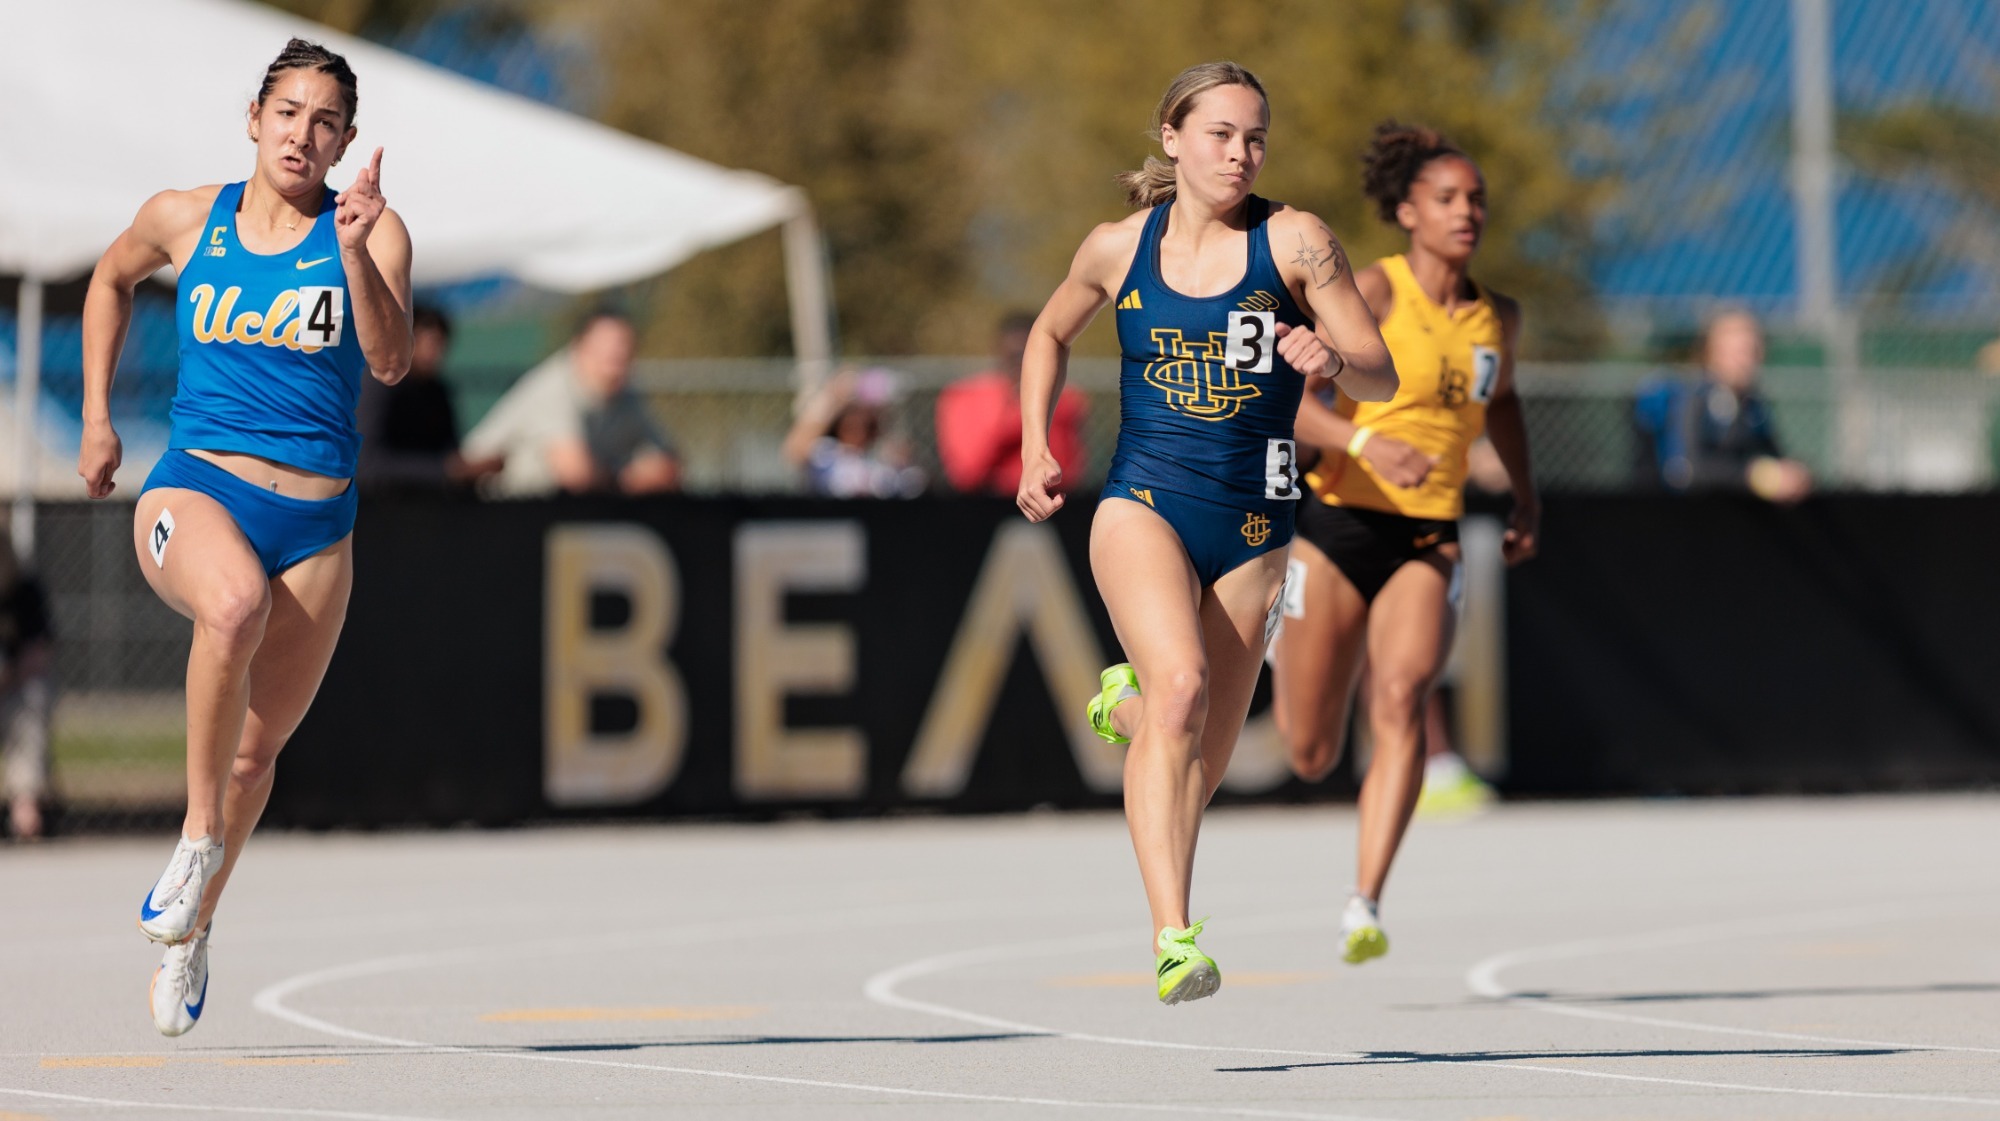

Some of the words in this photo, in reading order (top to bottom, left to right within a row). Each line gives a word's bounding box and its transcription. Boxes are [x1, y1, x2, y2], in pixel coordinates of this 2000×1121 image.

[210, 226, 227, 245] C
[307, 290, 336, 342] 4
[1236, 315, 1264, 369] 3
[1275, 442, 1293, 497] 3
[155, 520, 170, 556] 4
[543, 518, 1507, 806] BEA
